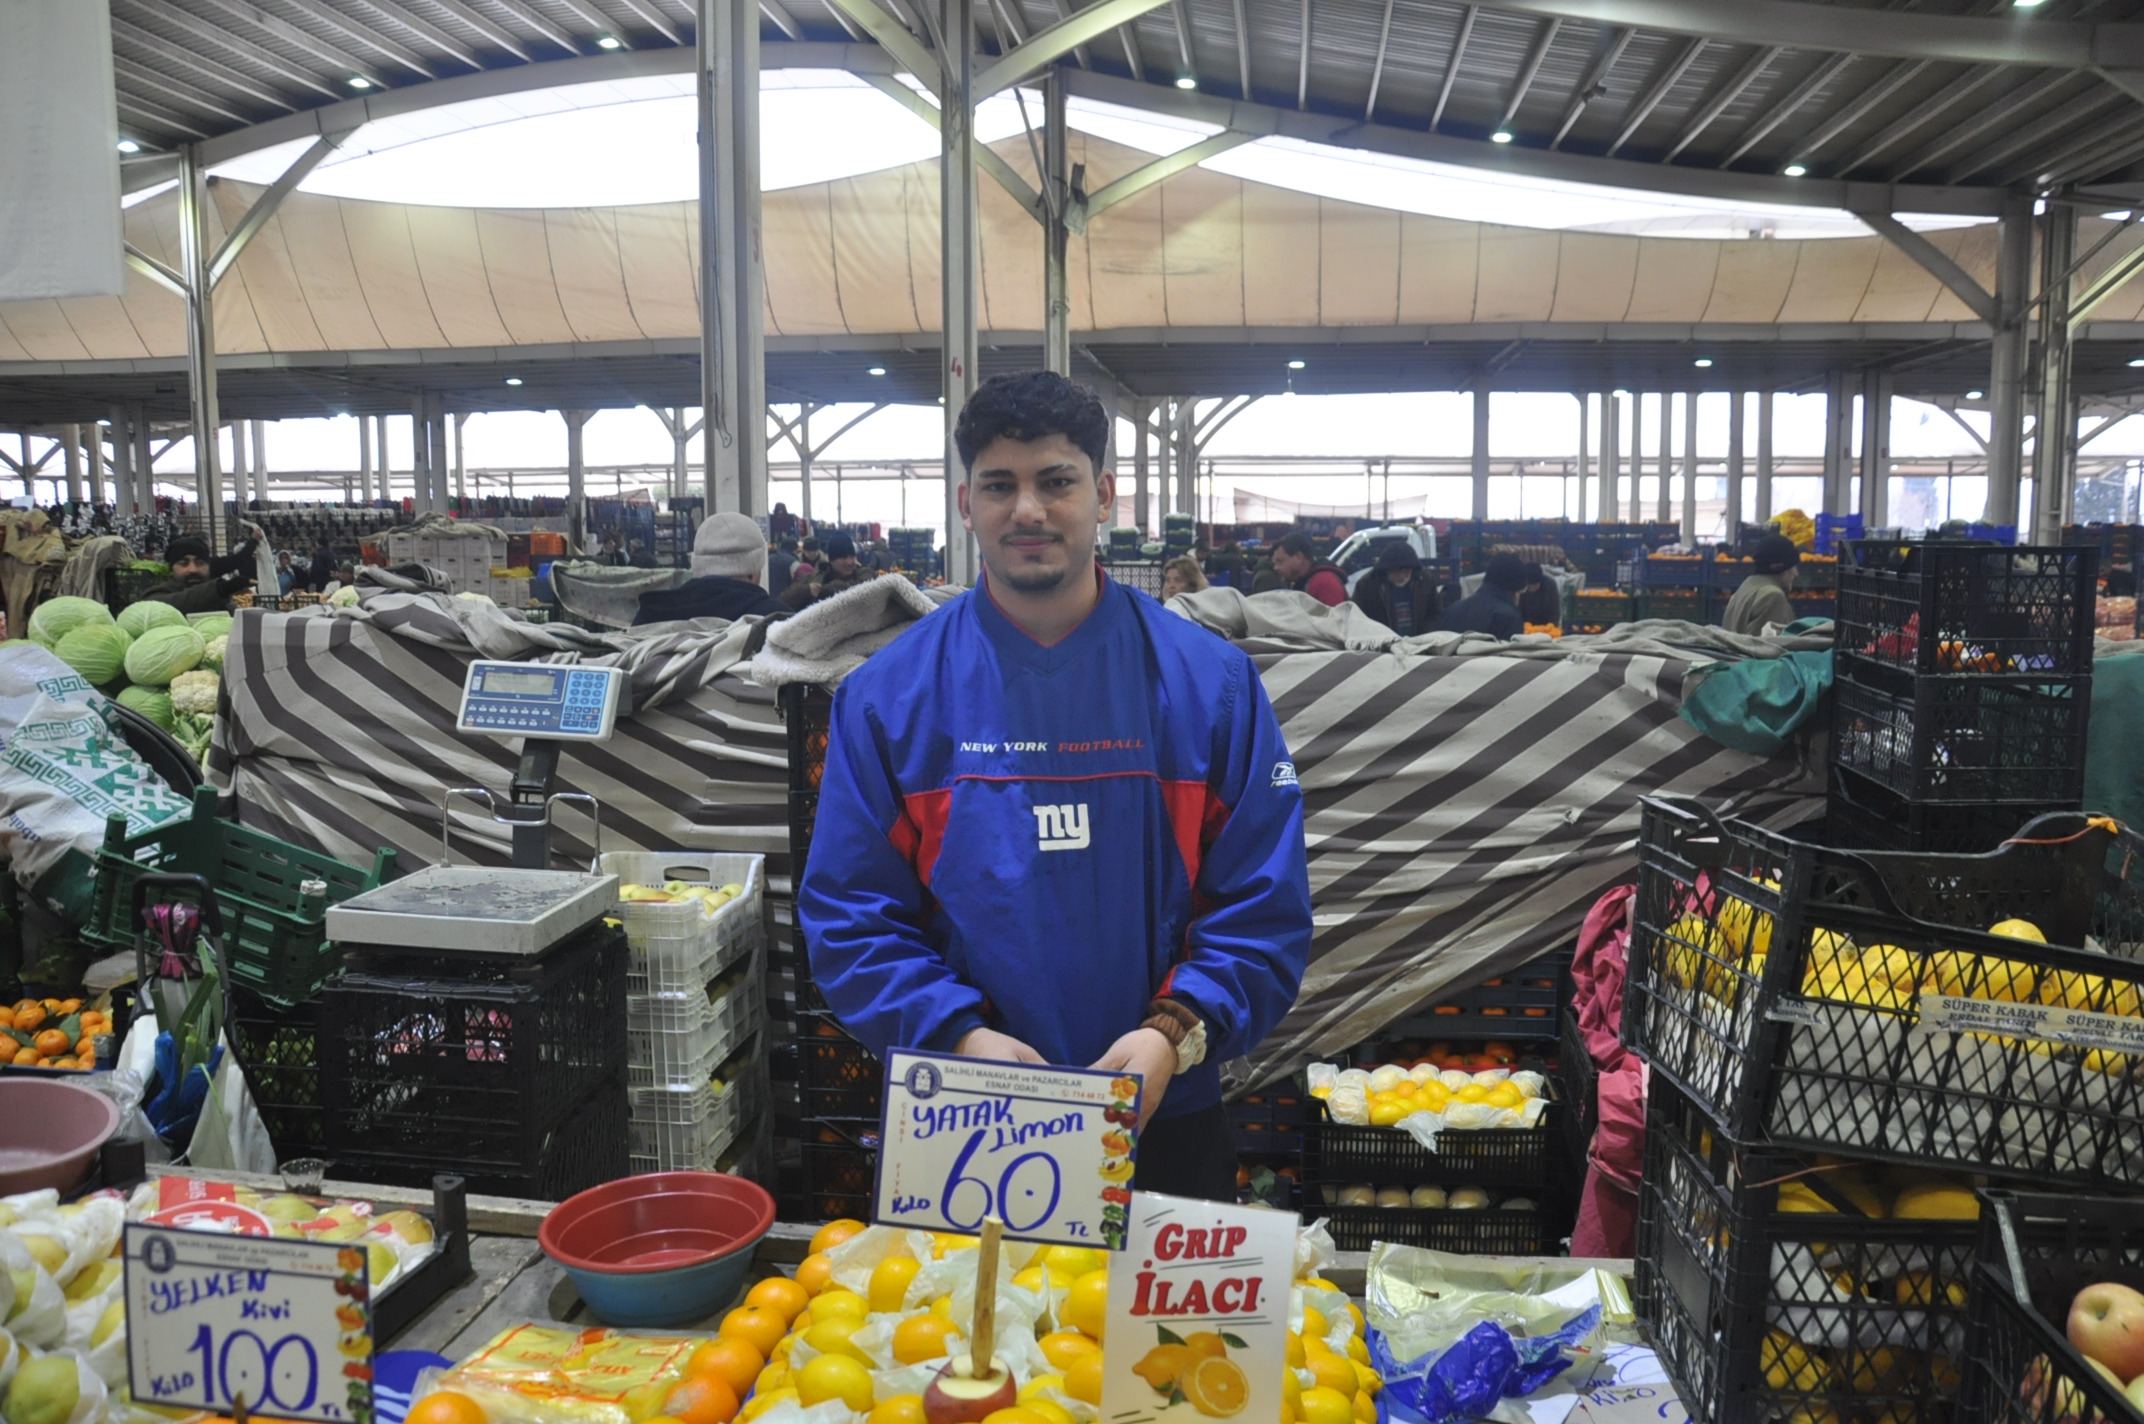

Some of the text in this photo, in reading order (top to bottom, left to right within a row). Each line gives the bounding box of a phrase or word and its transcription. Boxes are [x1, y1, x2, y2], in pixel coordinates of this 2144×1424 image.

[960, 739, 1144, 753] NEW YORK FOOTBALL
[1942, 998, 2048, 1021] SÜPER KABAK
[2066, 1014, 2144, 1032] SÜPER KA
[976, 1068, 1019, 1082] MANAVLAR
[1032, 1075, 1082, 1087] PAZARCILAR
[985, 1081, 1038, 1092] ESNAF ODASI
[913, 1096, 1014, 1139] YATAK
[940, 1128, 1061, 1233] 60
[1153, 1218, 1247, 1261] GRİP
[149, 1268, 271, 1313] YELKEN
[187, 1324, 318, 1414] 100
